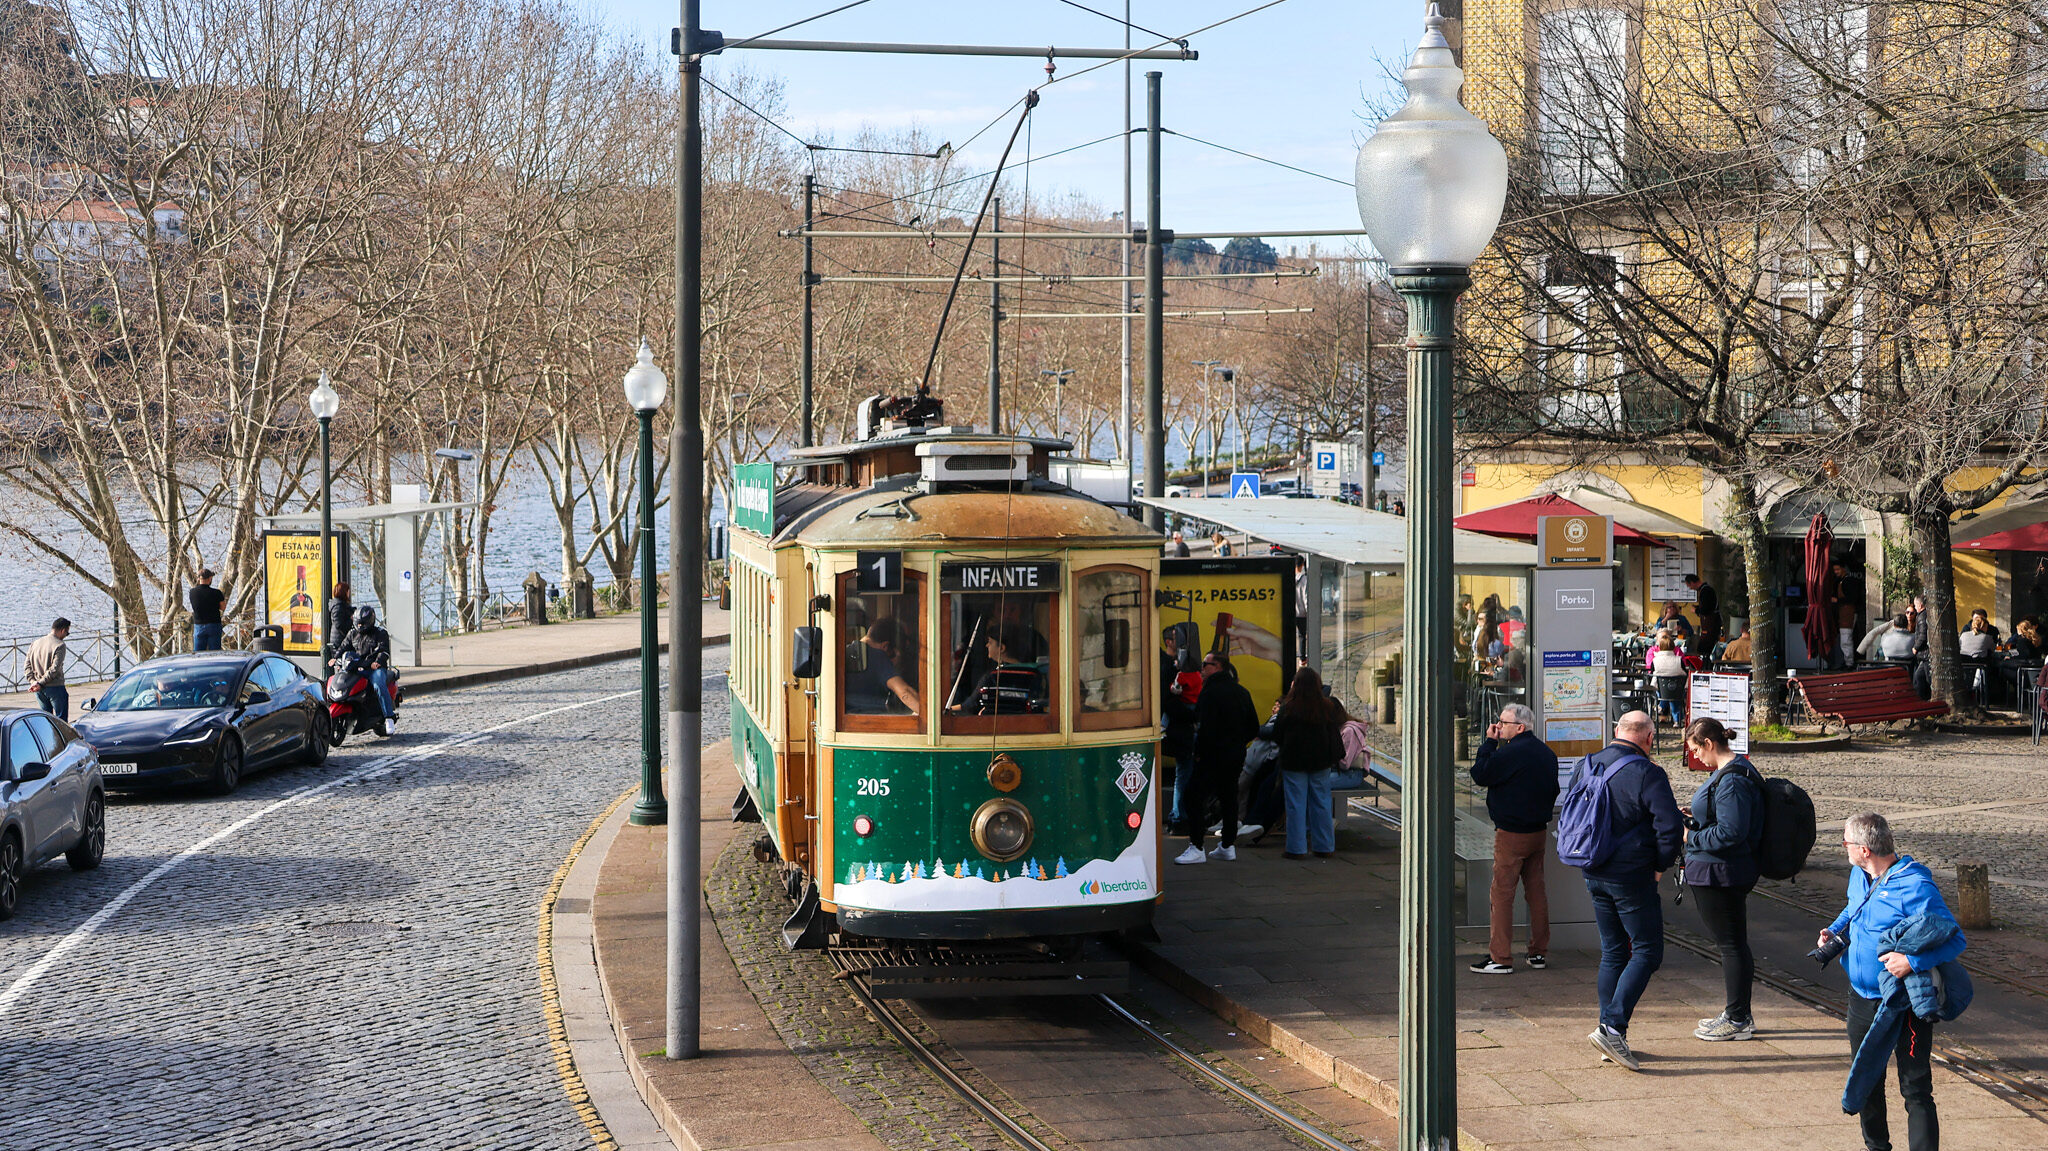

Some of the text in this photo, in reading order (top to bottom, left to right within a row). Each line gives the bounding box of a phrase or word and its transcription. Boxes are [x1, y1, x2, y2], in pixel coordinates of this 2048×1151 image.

[1320, 454, 1332, 469] P
[282, 541, 321, 551] ESTA NÃO
[274, 551, 322, 561] CHEGA A 20
[871, 556, 887, 588] 1
[962, 566, 1038, 588] INFANTE
[1187, 589, 1207, 604] 12,
[1211, 588, 1276, 602] PASSAS?
[1561, 595, 1590, 604] Porto.
[857, 777, 891, 797] 205
[1100, 879, 1148, 893] Iberdrola
